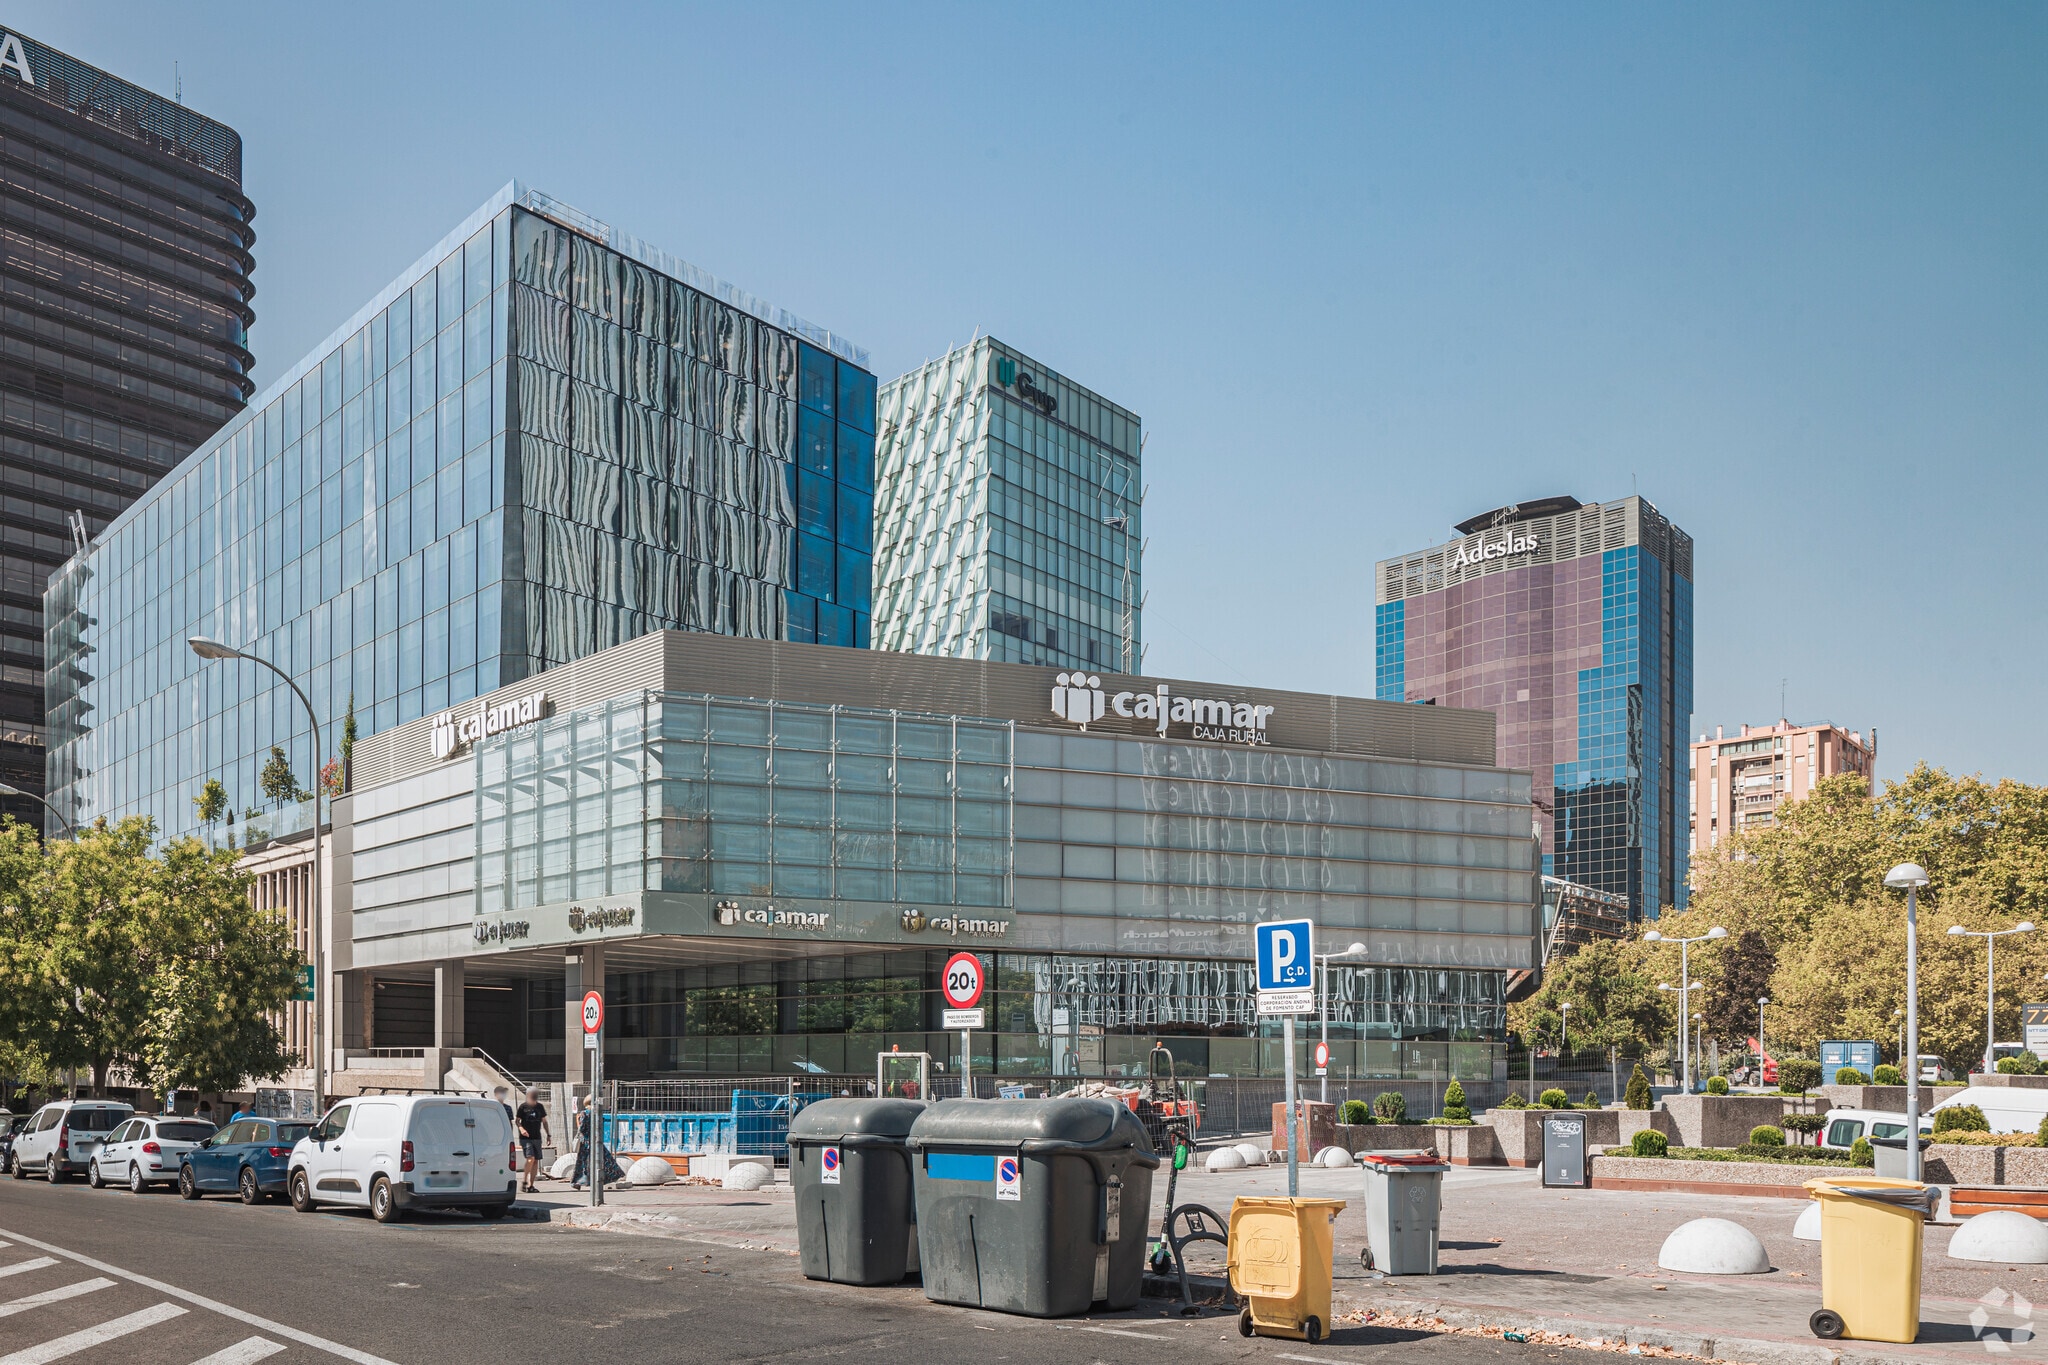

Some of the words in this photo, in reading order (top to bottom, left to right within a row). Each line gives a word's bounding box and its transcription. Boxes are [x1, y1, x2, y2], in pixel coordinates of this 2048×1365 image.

[0, 33, 34, 85] A
[1018, 373, 1057, 416] Gmp
[1452, 530, 1538, 570] Adeslas
[458, 691, 547, 743] cajamar
[1112, 684, 1274, 732] cajamar
[1193, 725, 1226, 741] CAJA
[1229, 729, 1271, 745] RURAL
[744, 905, 829, 928] cajamar
[930, 913, 1009, 936] cajamar
[1271, 929, 1296, 983] P
[1286, 966, 1308, 976] C.D.
